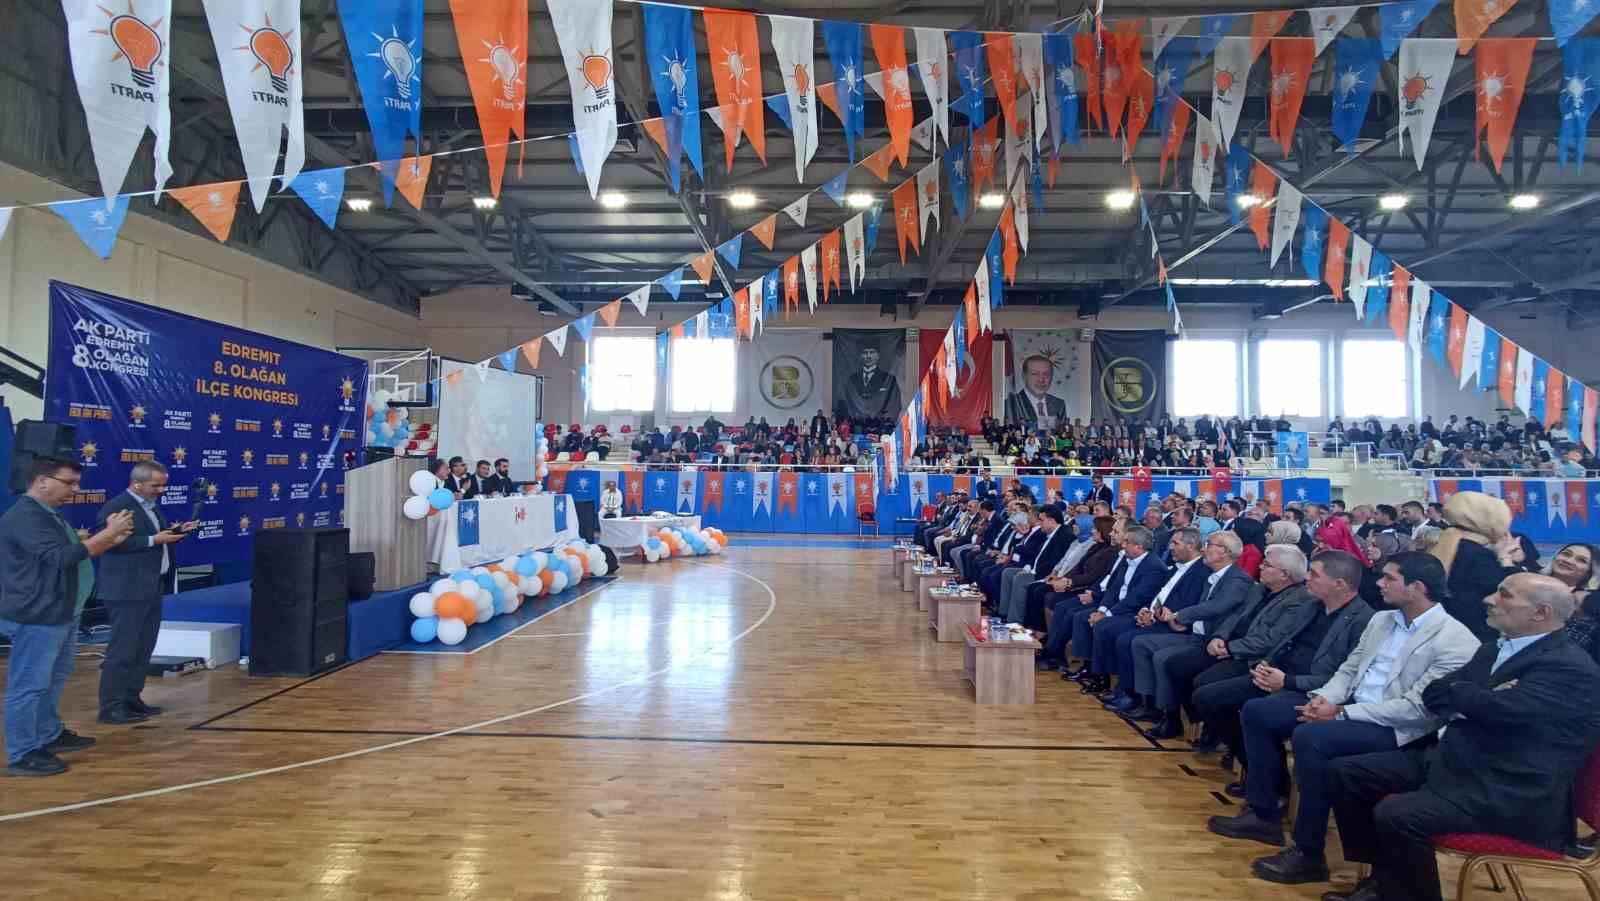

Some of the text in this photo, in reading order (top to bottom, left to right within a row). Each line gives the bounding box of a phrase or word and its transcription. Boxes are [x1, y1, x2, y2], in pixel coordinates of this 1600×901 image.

[73, 318, 151, 345] AK PARTİ
[213, 360, 287, 386] 8. OLAĞAN
